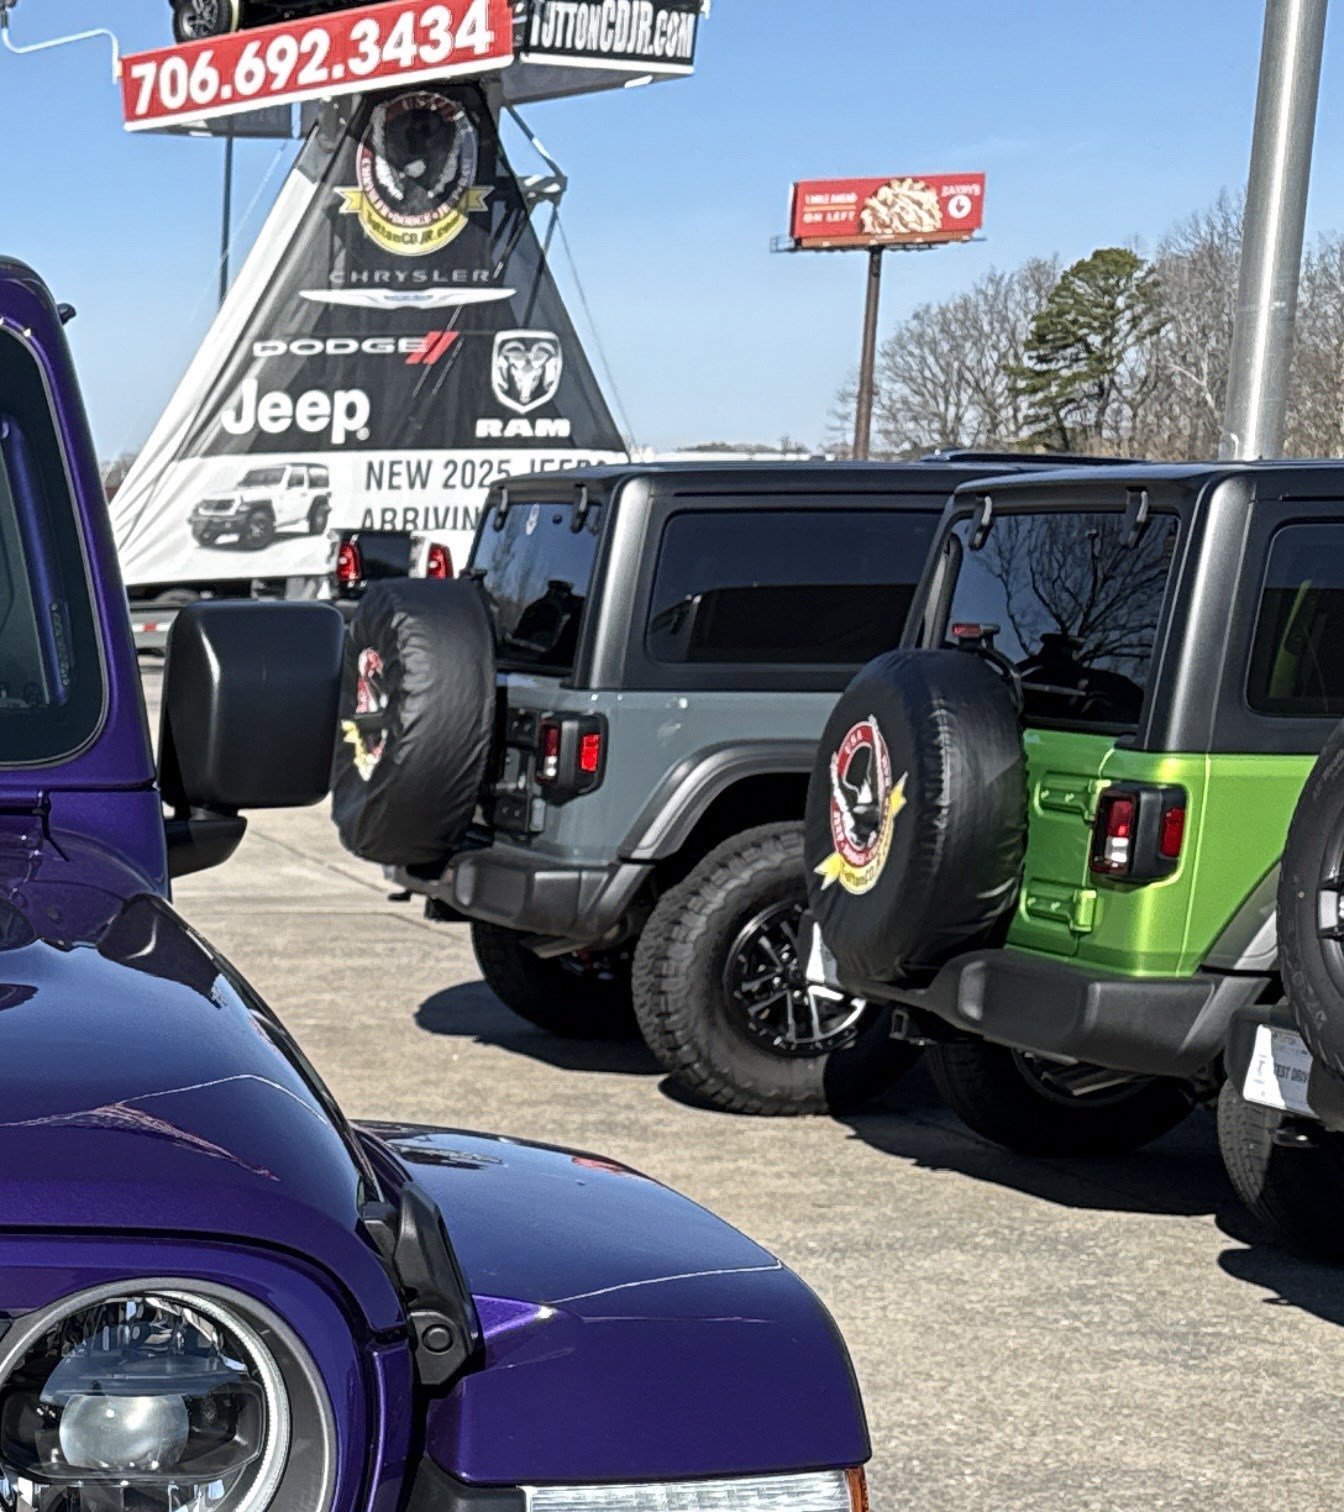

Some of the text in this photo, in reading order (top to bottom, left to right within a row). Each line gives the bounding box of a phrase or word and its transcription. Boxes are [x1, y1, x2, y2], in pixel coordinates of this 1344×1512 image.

[130, 0, 494, 115] 706.692.3434
[329, 269, 489, 284] CHRYSLER
[253, 337, 428, 357] DODGE
[221, 378, 371, 444] Jeep
[475, 418, 570, 438] RAM
[365, 460, 432, 491] NEW
[442, 459, 511, 490] 2025
